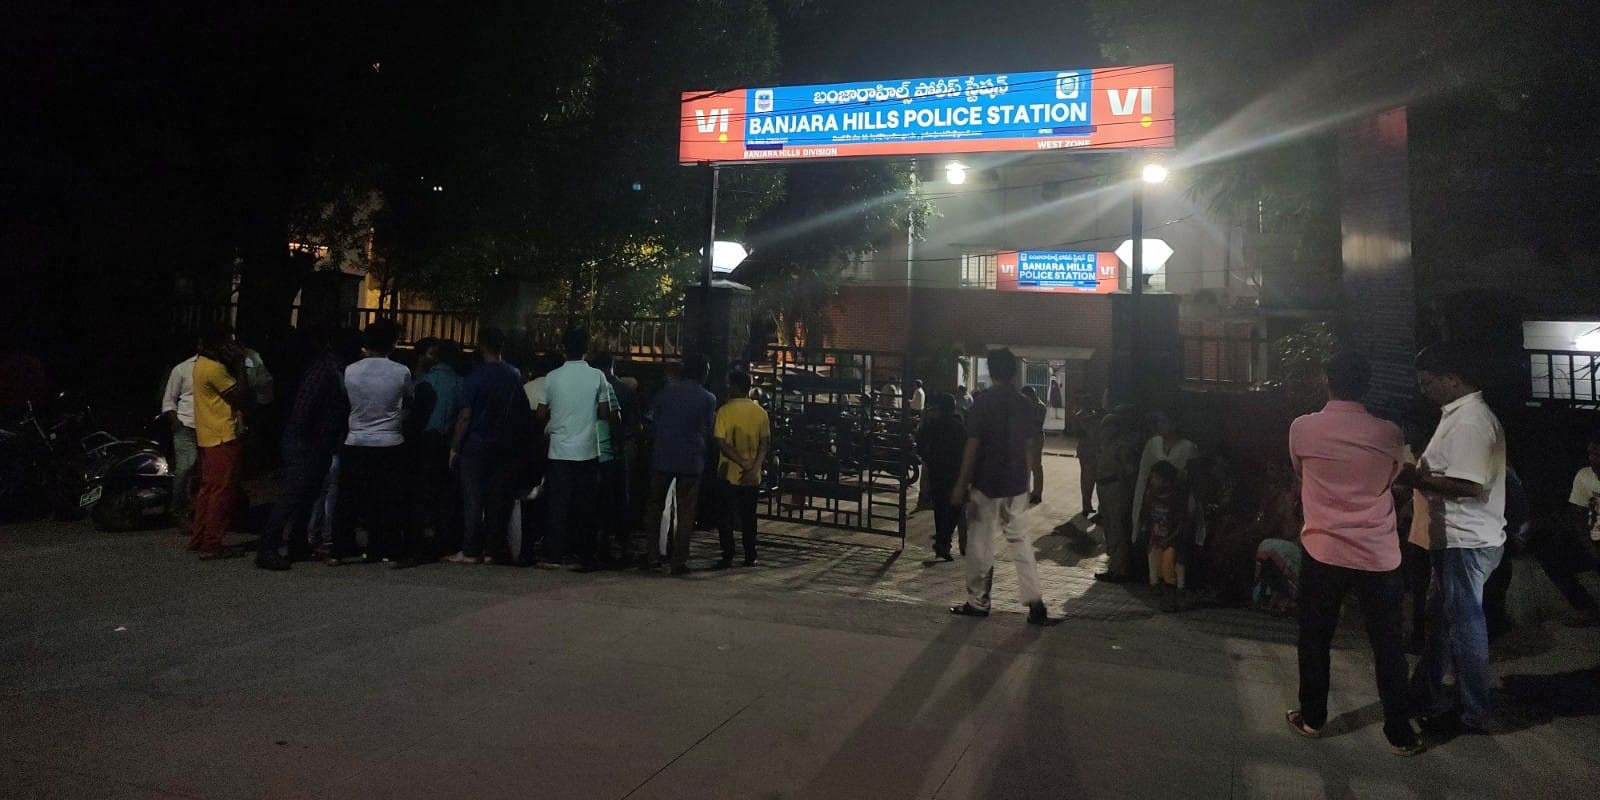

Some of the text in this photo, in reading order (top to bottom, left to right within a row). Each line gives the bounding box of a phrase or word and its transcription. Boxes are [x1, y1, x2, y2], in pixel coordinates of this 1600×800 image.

[749, 102, 1087, 135] BANJARA HILLS POLICE STATION
[1037, 139, 1091, 149] WEST ZONE
[744, 148, 838, 159] BANJARA HILLS DIVISION
[1022, 262, 1093, 272] BANJARA HILLS
[1019, 271, 1096, 280] POLICE STATION
